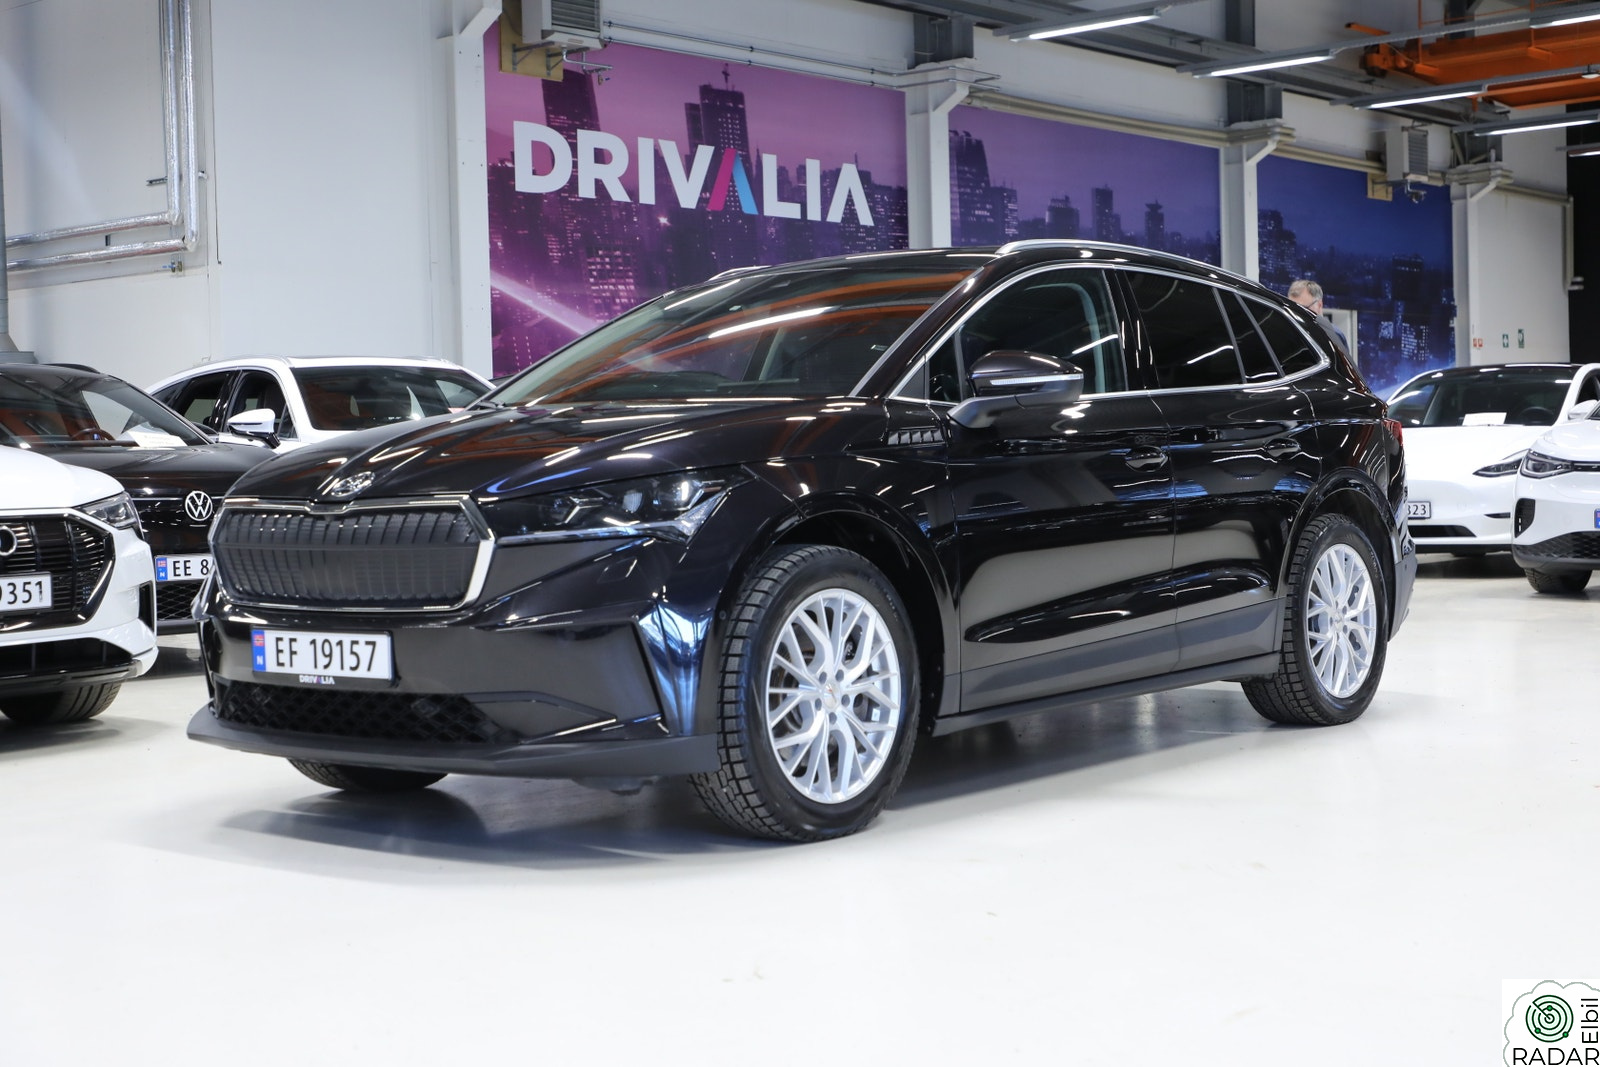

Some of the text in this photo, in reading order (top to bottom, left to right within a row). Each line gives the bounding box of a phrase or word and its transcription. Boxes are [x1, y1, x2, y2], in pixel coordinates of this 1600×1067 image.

[513, 120, 874, 226] DRIVALIA
[173, 560, 192, 577] EE
[0, 580, 43, 605] 351
[256, 655, 264, 665] N
[275, 637, 377, 672] EF 19157
[299, 674, 335, 685] DRIVALIA
